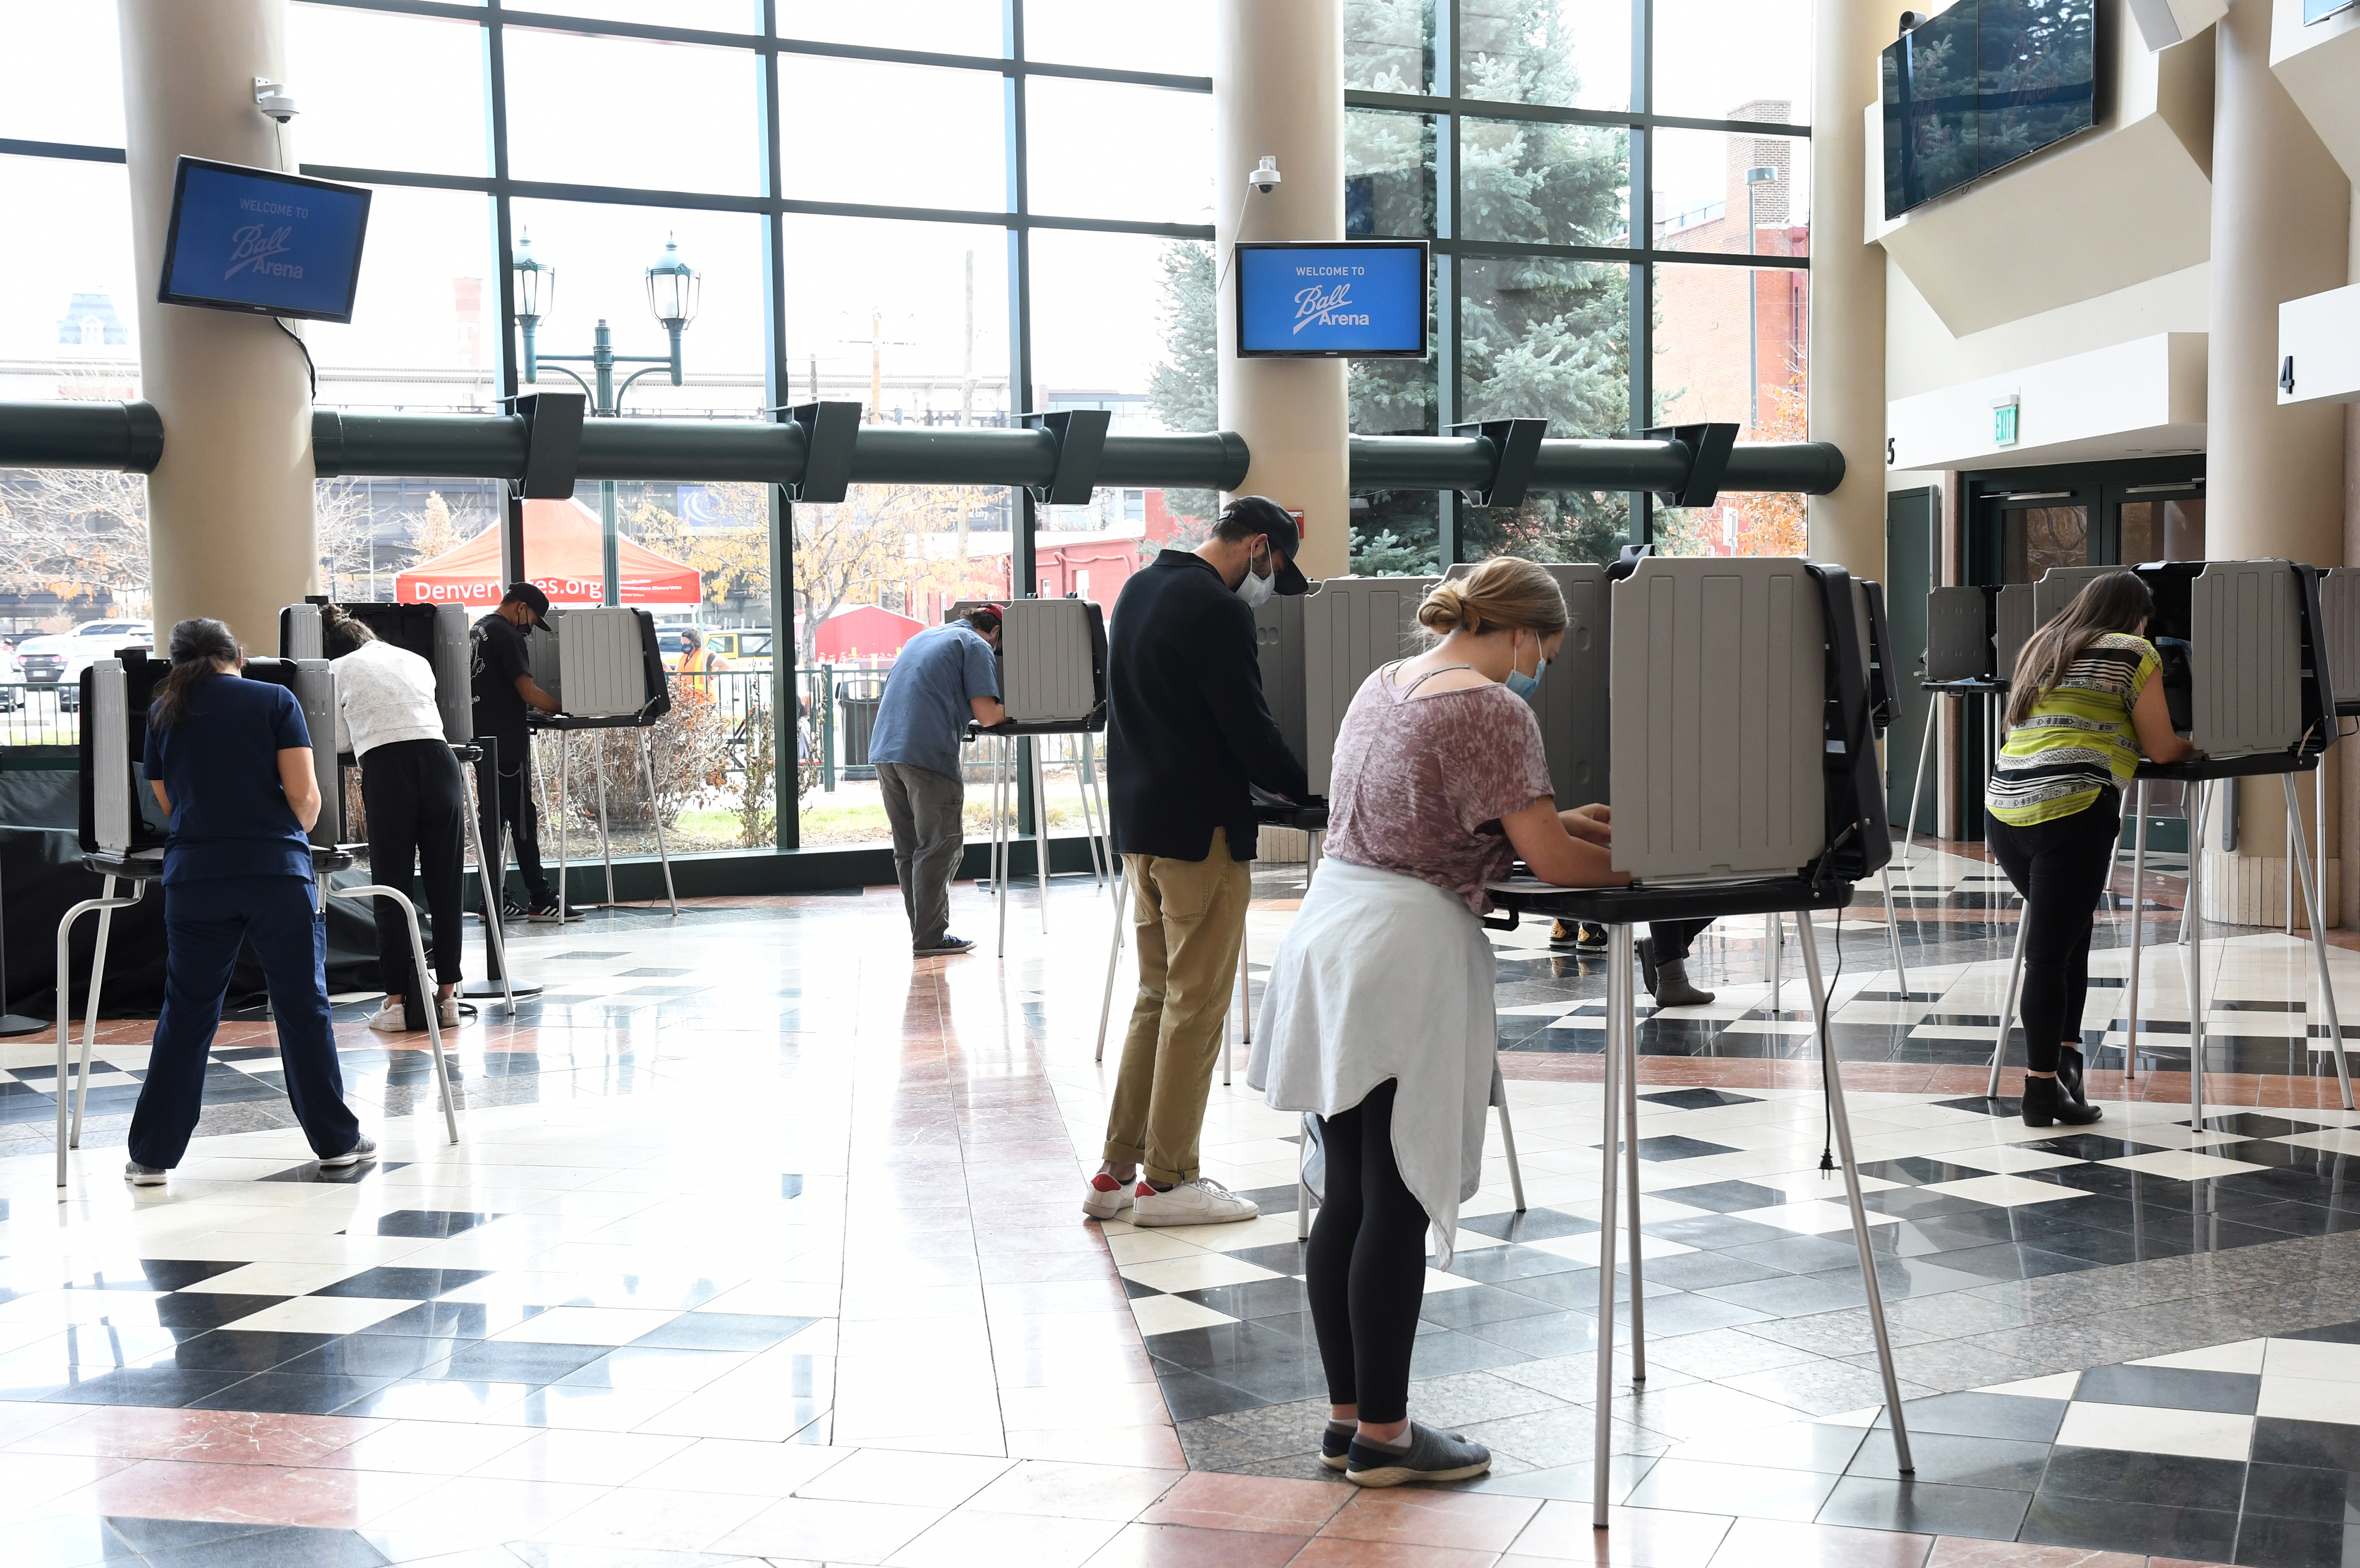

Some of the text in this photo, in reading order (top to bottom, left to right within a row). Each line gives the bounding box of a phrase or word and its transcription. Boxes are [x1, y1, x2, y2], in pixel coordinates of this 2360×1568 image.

[240, 198, 308, 219] WELCOME TO
[229, 224, 292, 261] Ball
[252, 256, 304, 280] Arena
[1295, 266, 1365, 276] WELCOME TO
[1294, 283, 1353, 319] Ball
[1318, 310, 1369, 325] Arena
[2279, 356, 2295, 394] 4
[1996, 409, 2011, 441] EXIT
[1887, 437, 1894, 465] 5
[415, 578, 603, 599] DenverVes.org
